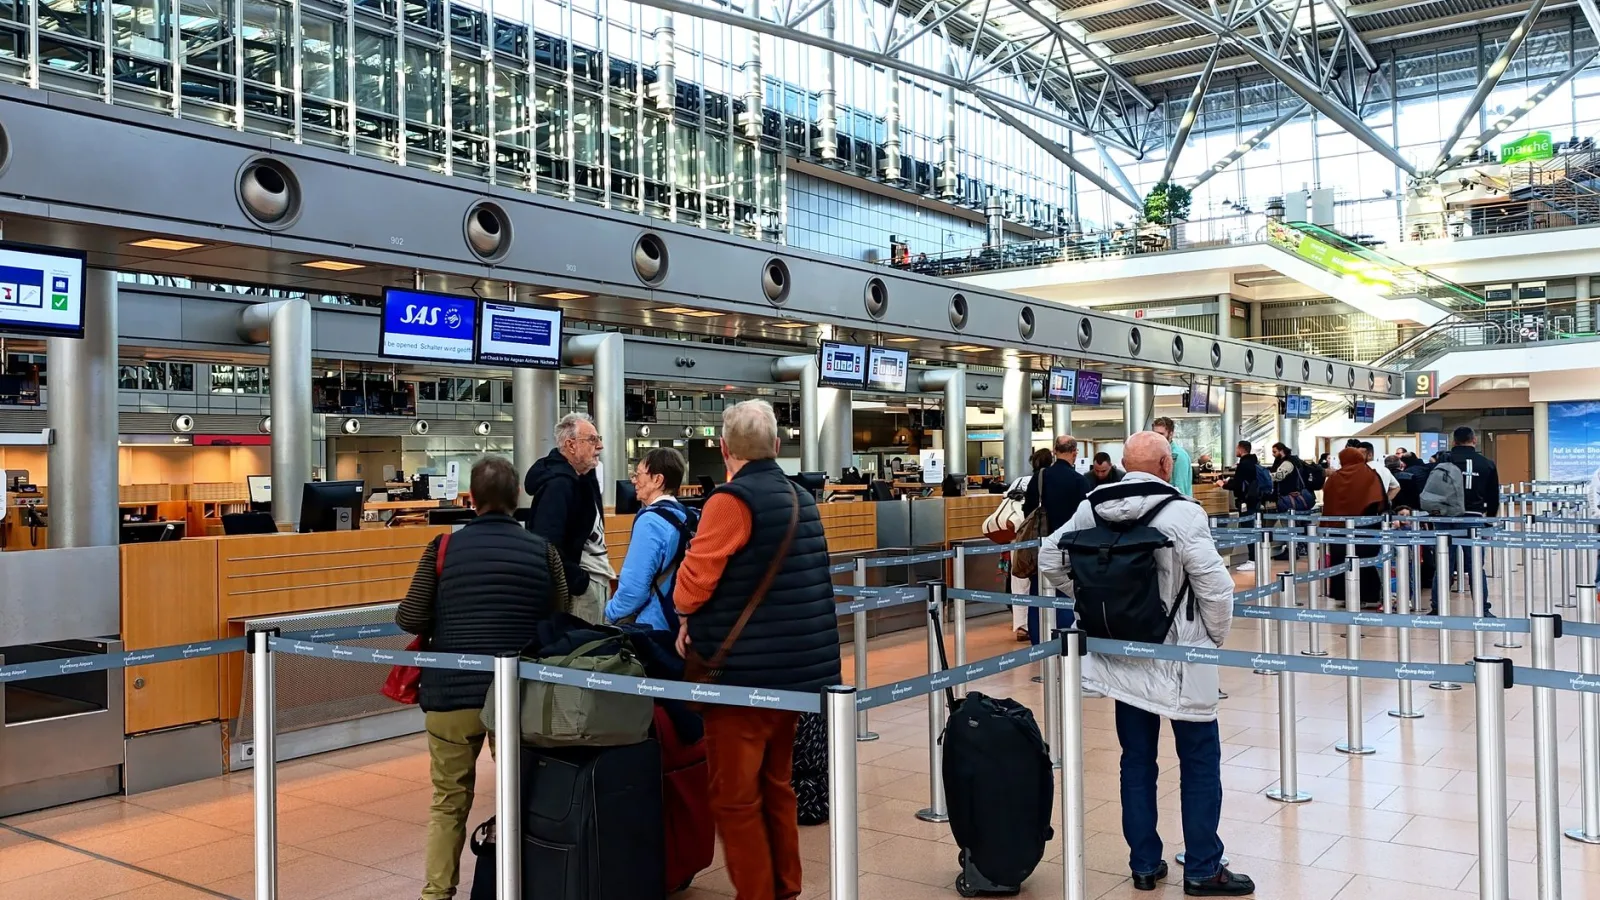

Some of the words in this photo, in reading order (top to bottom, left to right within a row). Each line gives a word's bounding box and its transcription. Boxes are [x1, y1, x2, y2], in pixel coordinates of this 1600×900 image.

[1504, 140, 1549, 156] marché
[390, 236, 404, 246] 902
[400, 304, 442, 326] SAS
[1417, 374, 1429, 390] 9
